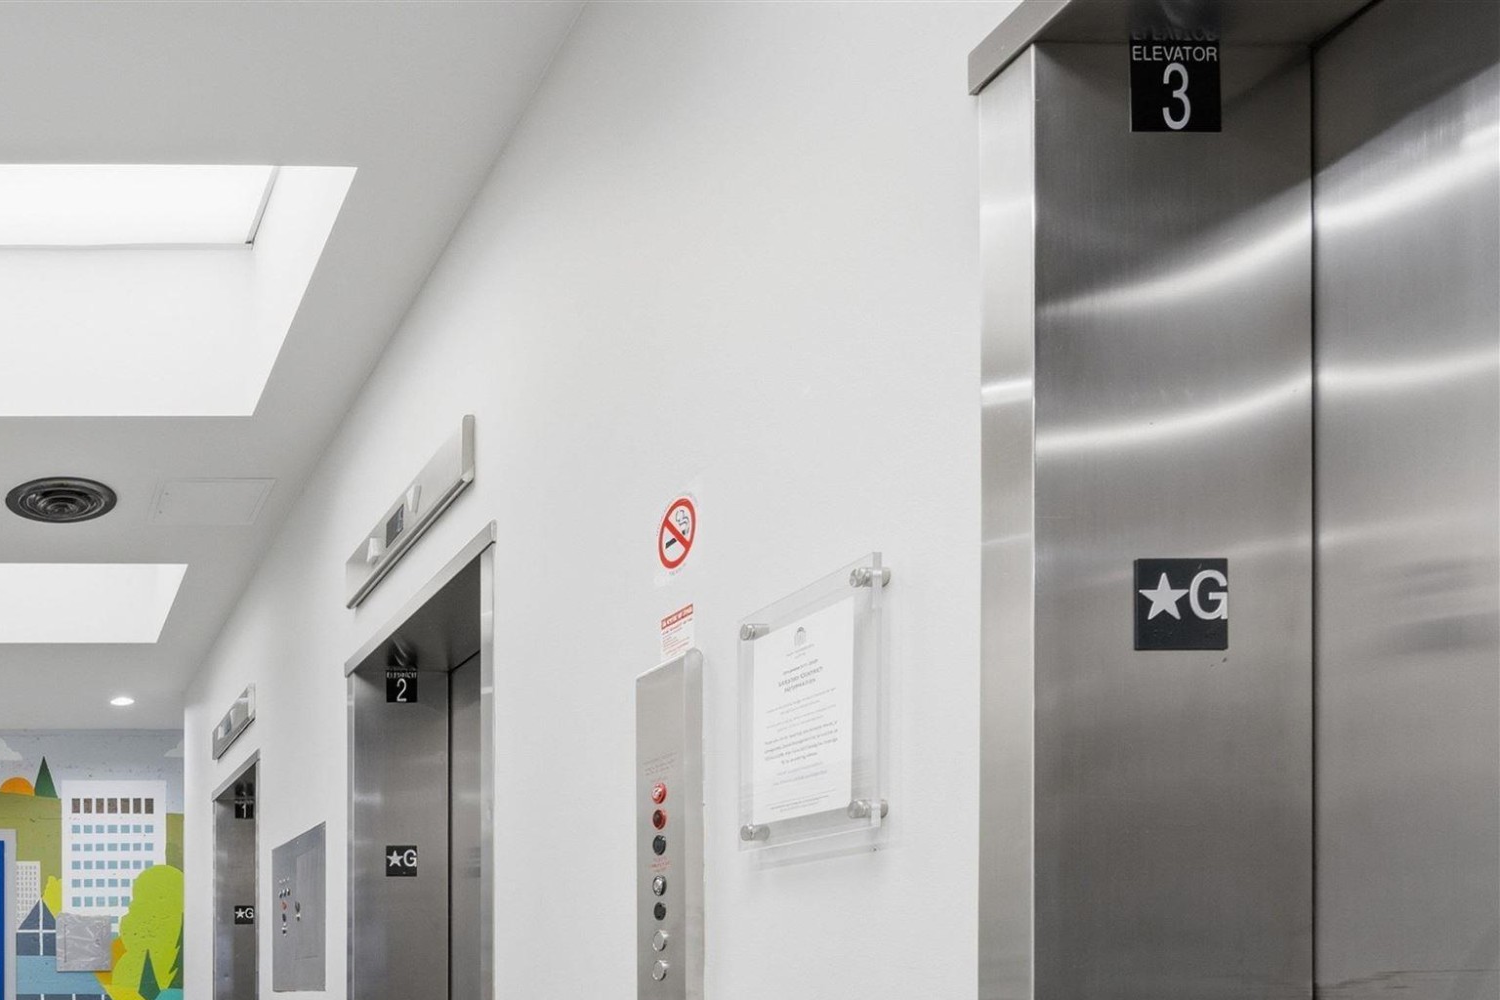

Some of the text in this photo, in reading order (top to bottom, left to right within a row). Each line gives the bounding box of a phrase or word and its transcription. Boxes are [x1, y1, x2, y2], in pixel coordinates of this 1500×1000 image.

[1132, 46, 1217, 62] ELEVATOR
[1162, 63, 1191, 130] 3
[1189, 569, 1228, 620] G
[396, 678, 407, 702] 2
[241, 803, 247, 819] 1
[404, 849, 417, 867] G
[245, 908, 254, 919] G
